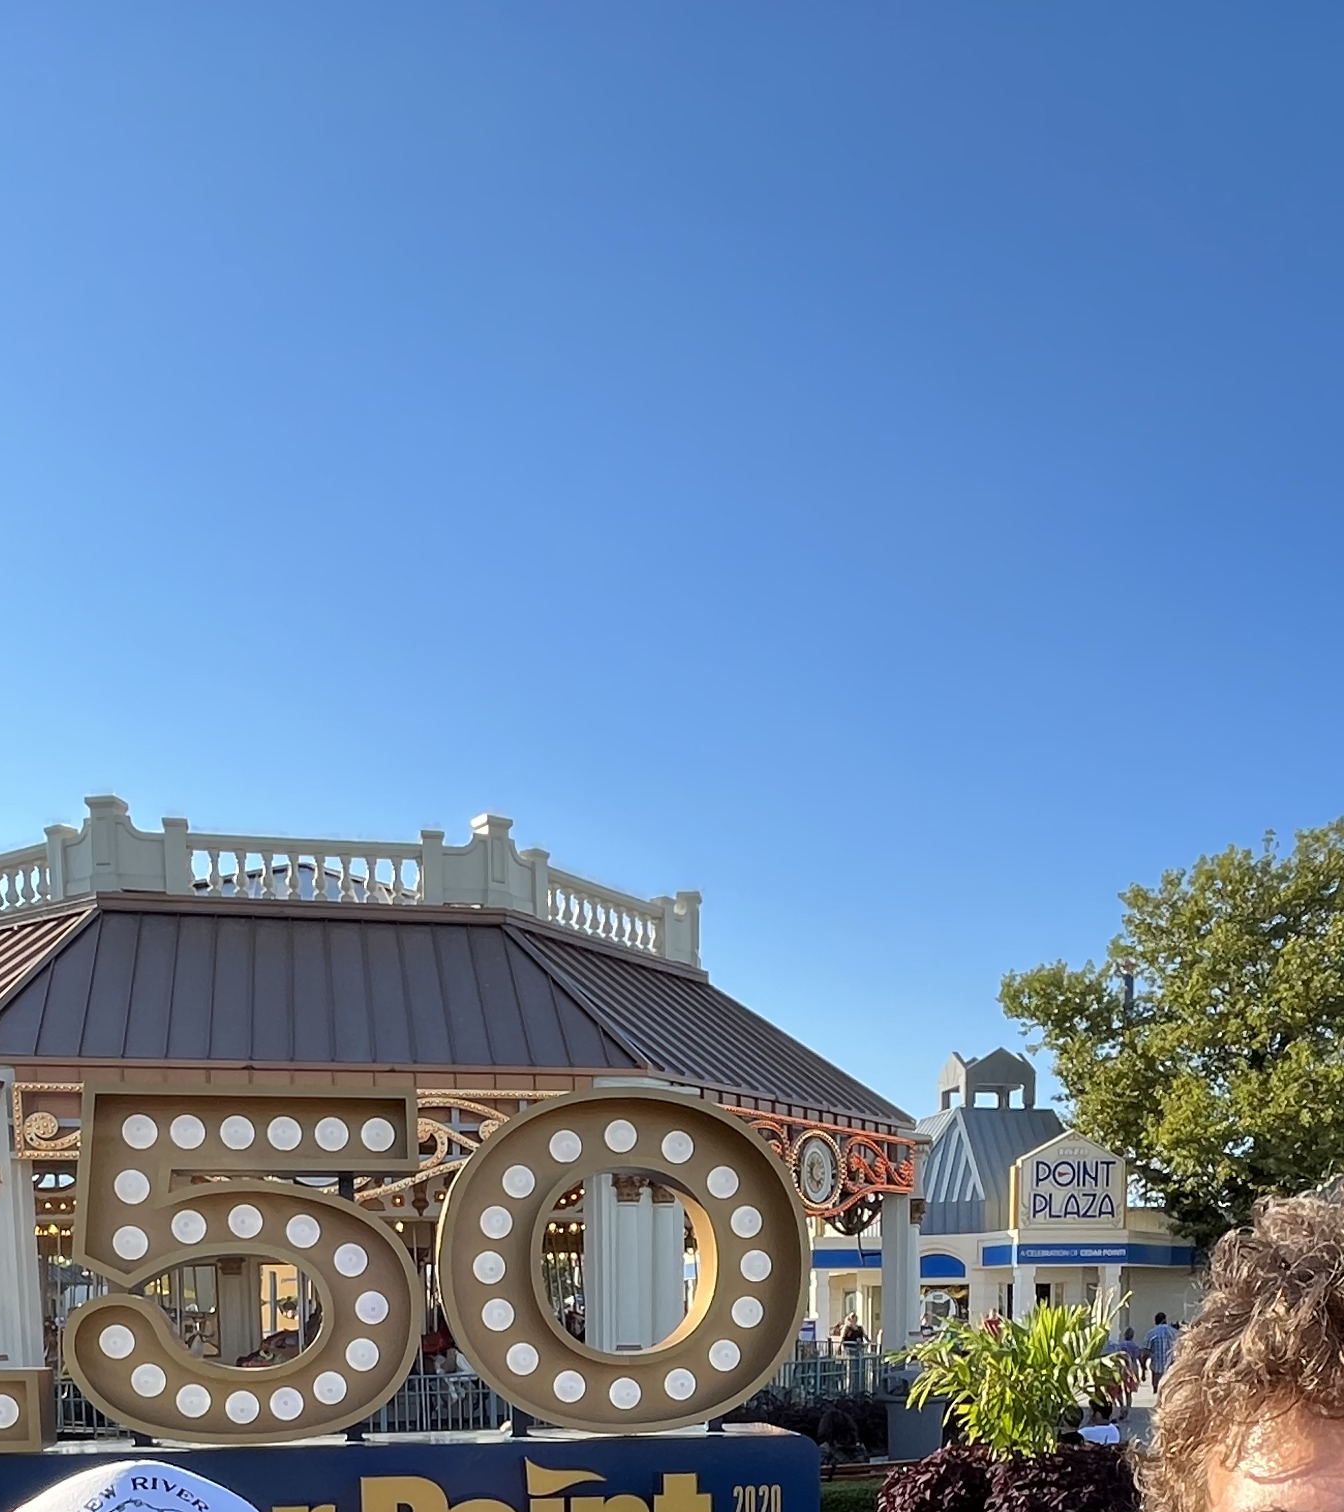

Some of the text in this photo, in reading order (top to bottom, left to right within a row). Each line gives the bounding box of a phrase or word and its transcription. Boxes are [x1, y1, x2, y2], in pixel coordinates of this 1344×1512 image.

[1035, 1160, 1116, 1187] POINT
[1032, 1193, 1115, 1218] PLAZA
[130, 1475, 210, 1512] RIVER
